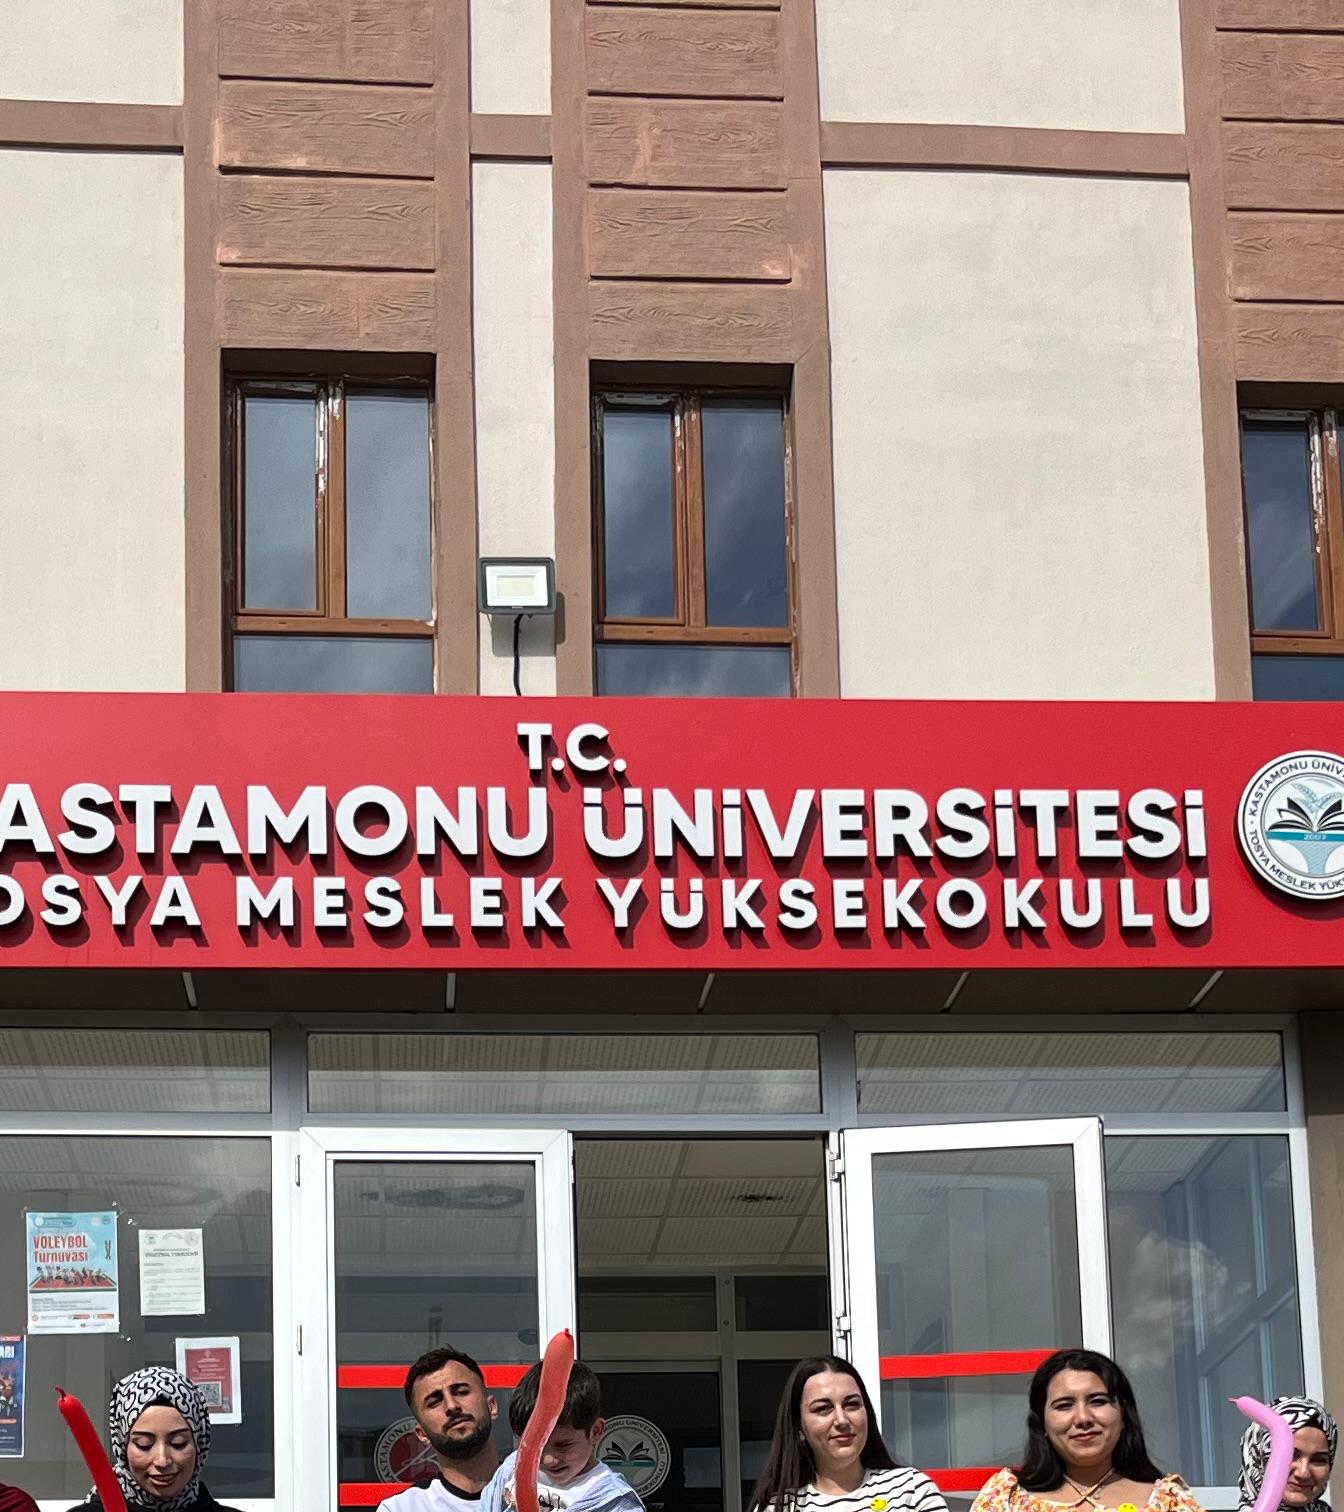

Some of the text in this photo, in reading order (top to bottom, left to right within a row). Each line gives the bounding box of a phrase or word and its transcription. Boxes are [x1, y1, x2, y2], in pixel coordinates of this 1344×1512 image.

[518, 723, 626, 771] T.C.
[1248, 760, 1308, 817] KASTAMONU
[1249, 829, 1270, 867] TOSYA
[1270, 864, 1317, 891] MESLEK
[236, 876, 564, 927] MESLEK
[597, 878, 1209, 928] YÜKSEKOKULU
[33, 1235, 88, 1249] VOLEYBOL
[379, 1422, 412, 1480] ASTAMONU
